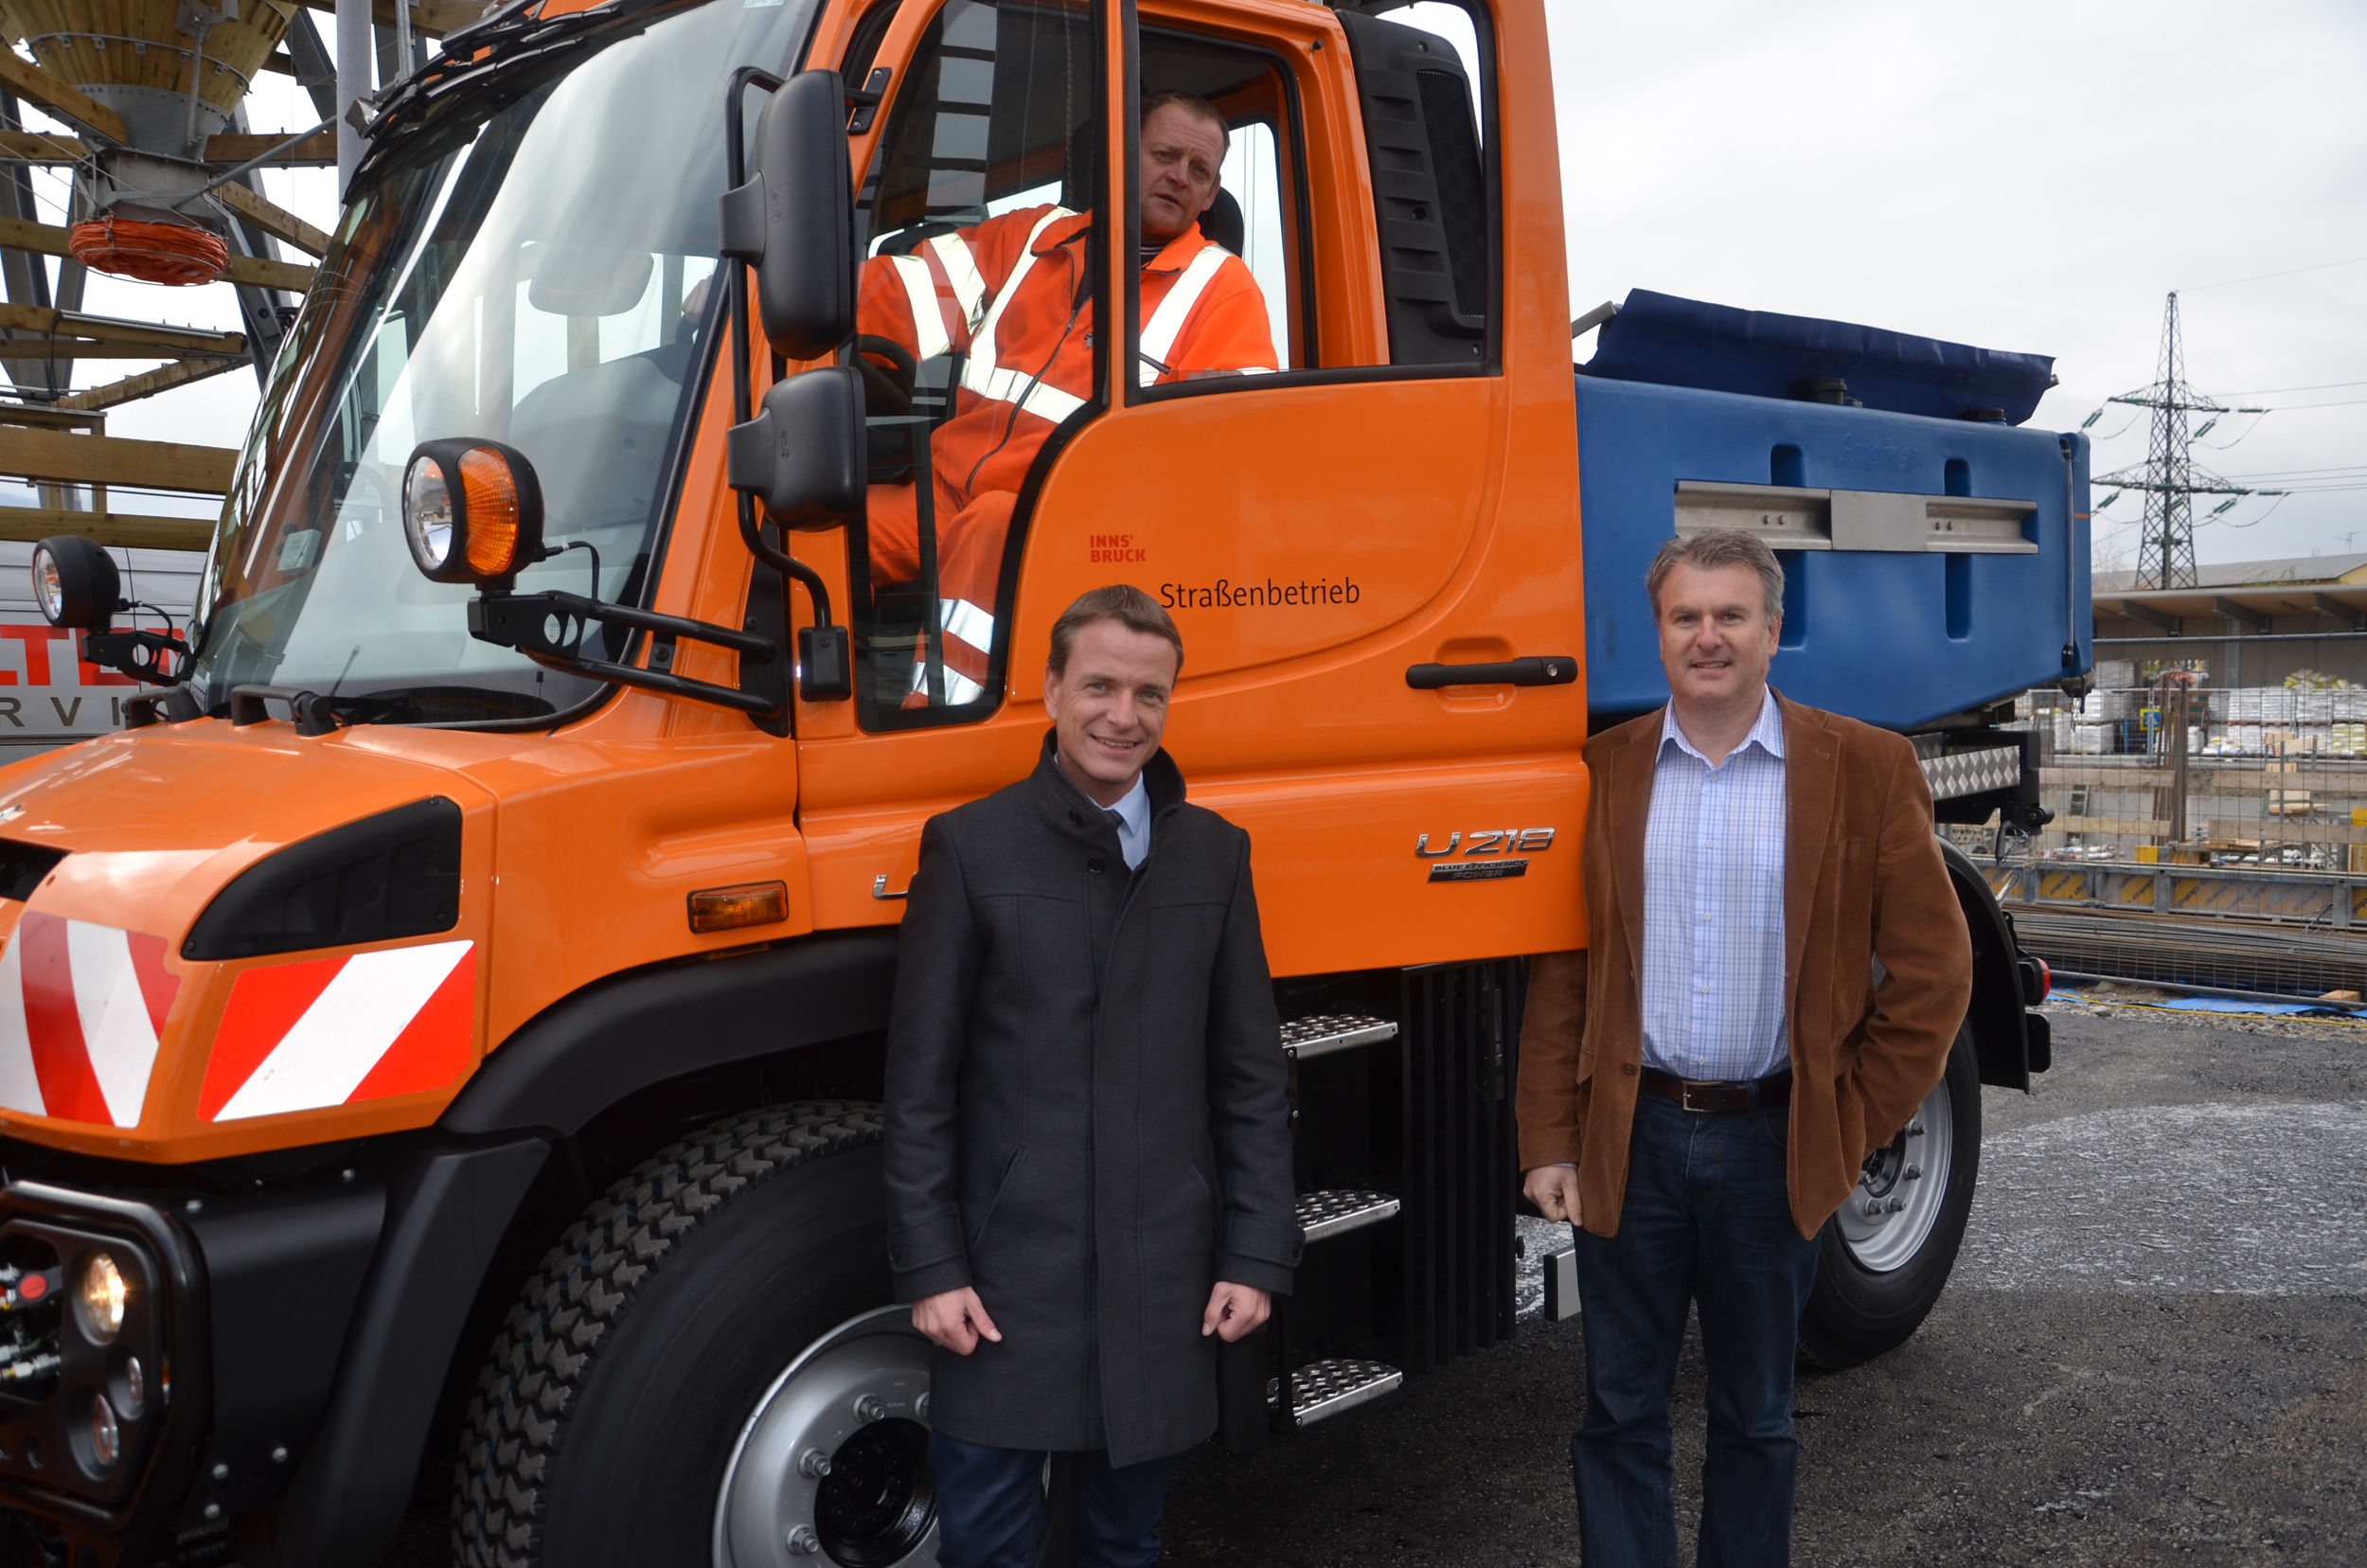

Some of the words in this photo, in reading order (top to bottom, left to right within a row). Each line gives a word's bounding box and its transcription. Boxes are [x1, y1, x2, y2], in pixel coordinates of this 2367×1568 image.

[1090, 549, 1147, 563] BRUCK
[1160, 577, 1361, 609] Straßenbetrieb
[1415, 831, 1462, 858] U
[1464, 827, 1556, 856] 218
[1465, 860, 1528, 870] EFFICIENCY
[1452, 870, 1504, 880] POWER
